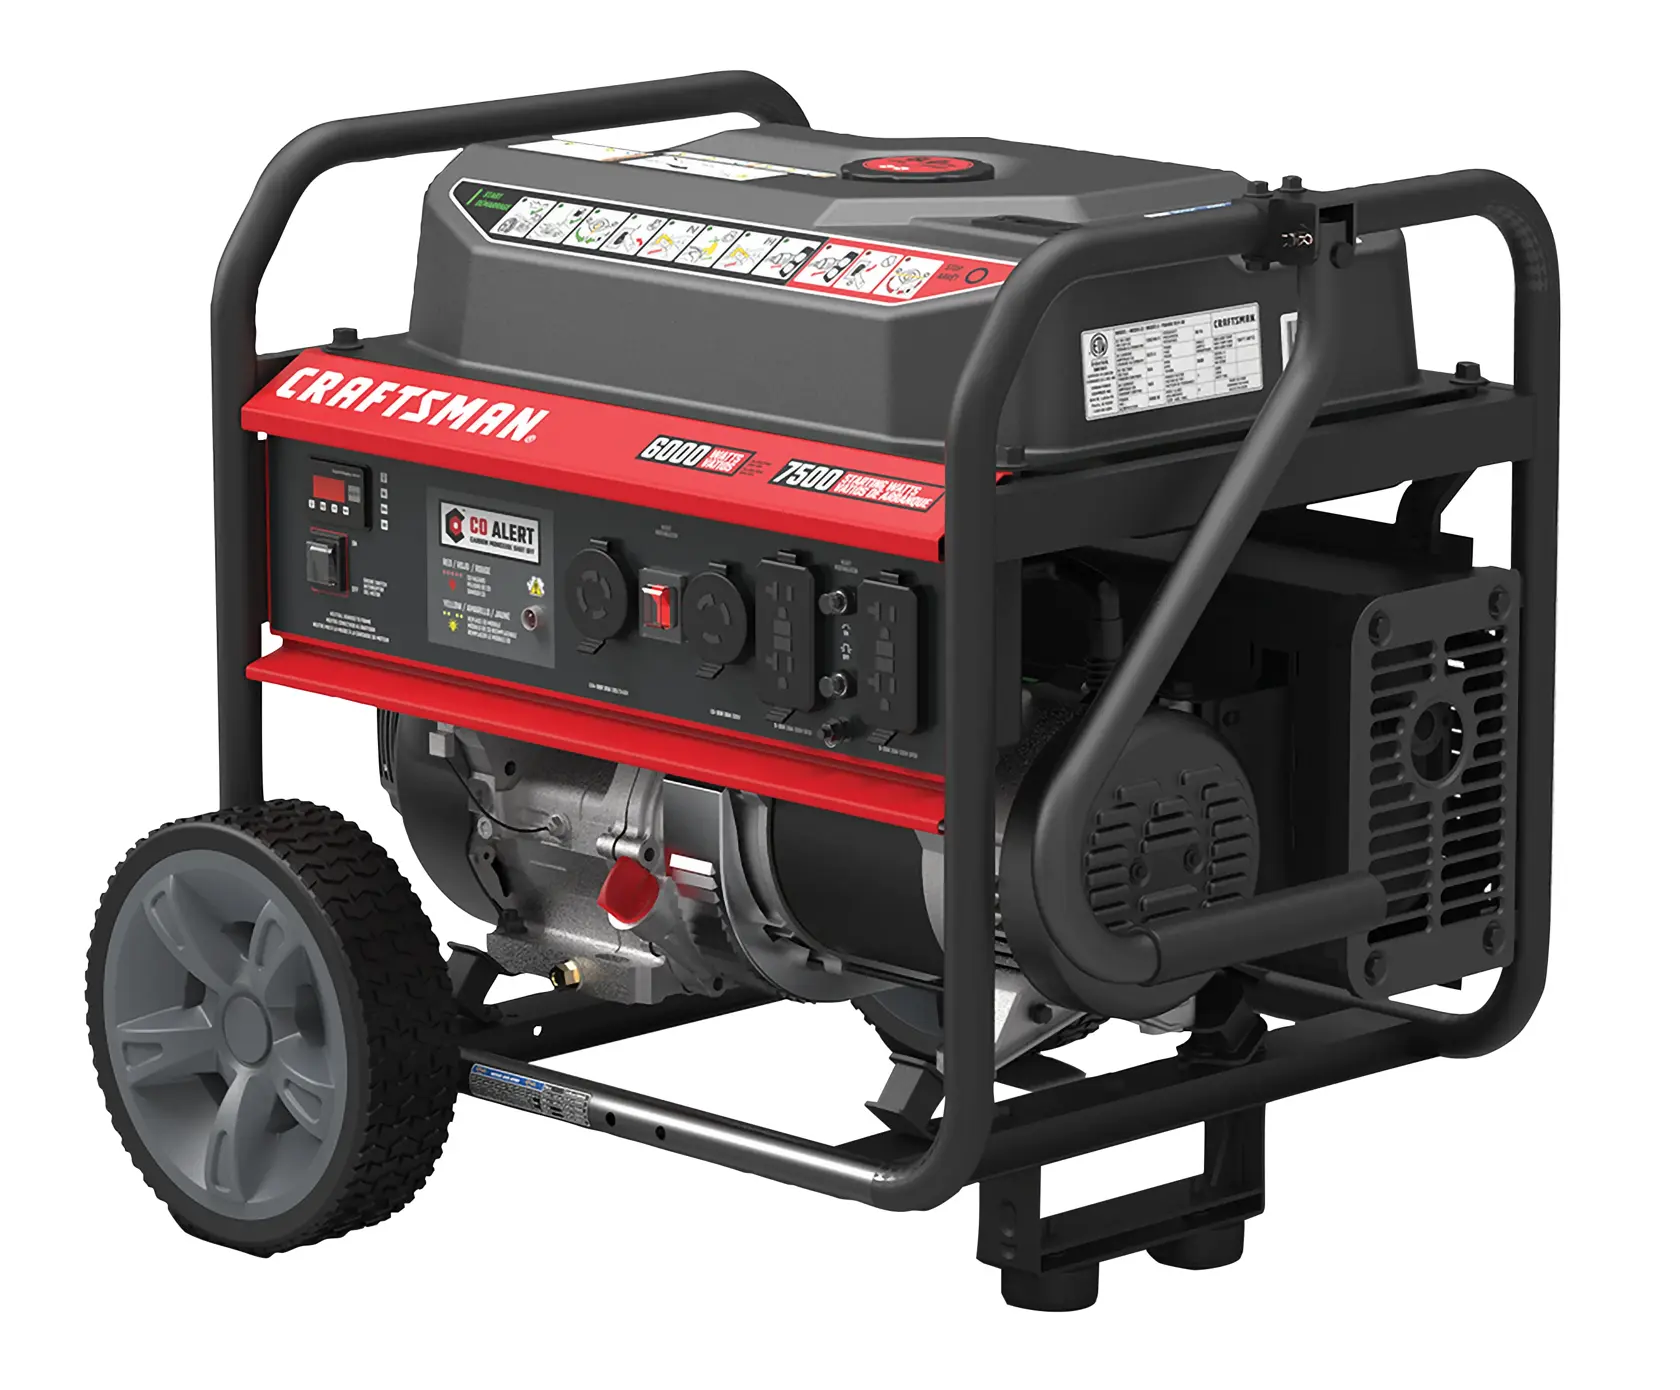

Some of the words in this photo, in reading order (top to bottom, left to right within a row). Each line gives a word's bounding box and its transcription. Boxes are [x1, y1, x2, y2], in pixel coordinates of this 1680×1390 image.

[1213, 313, 1256, 329] CRAFTSMAN
[276, 367, 550, 442] CRAFTSMAN
[640, 436, 712, 467] 6000
[709, 449, 745, 464] WATTS
[701, 457, 737, 473] VATIOS
[773, 460, 844, 492] 7500
[841, 473, 889, 493] STARTING
[884, 480, 923, 496] WATTS
[469, 516, 488, 536] CO
[491, 520, 535, 545] ALERT
